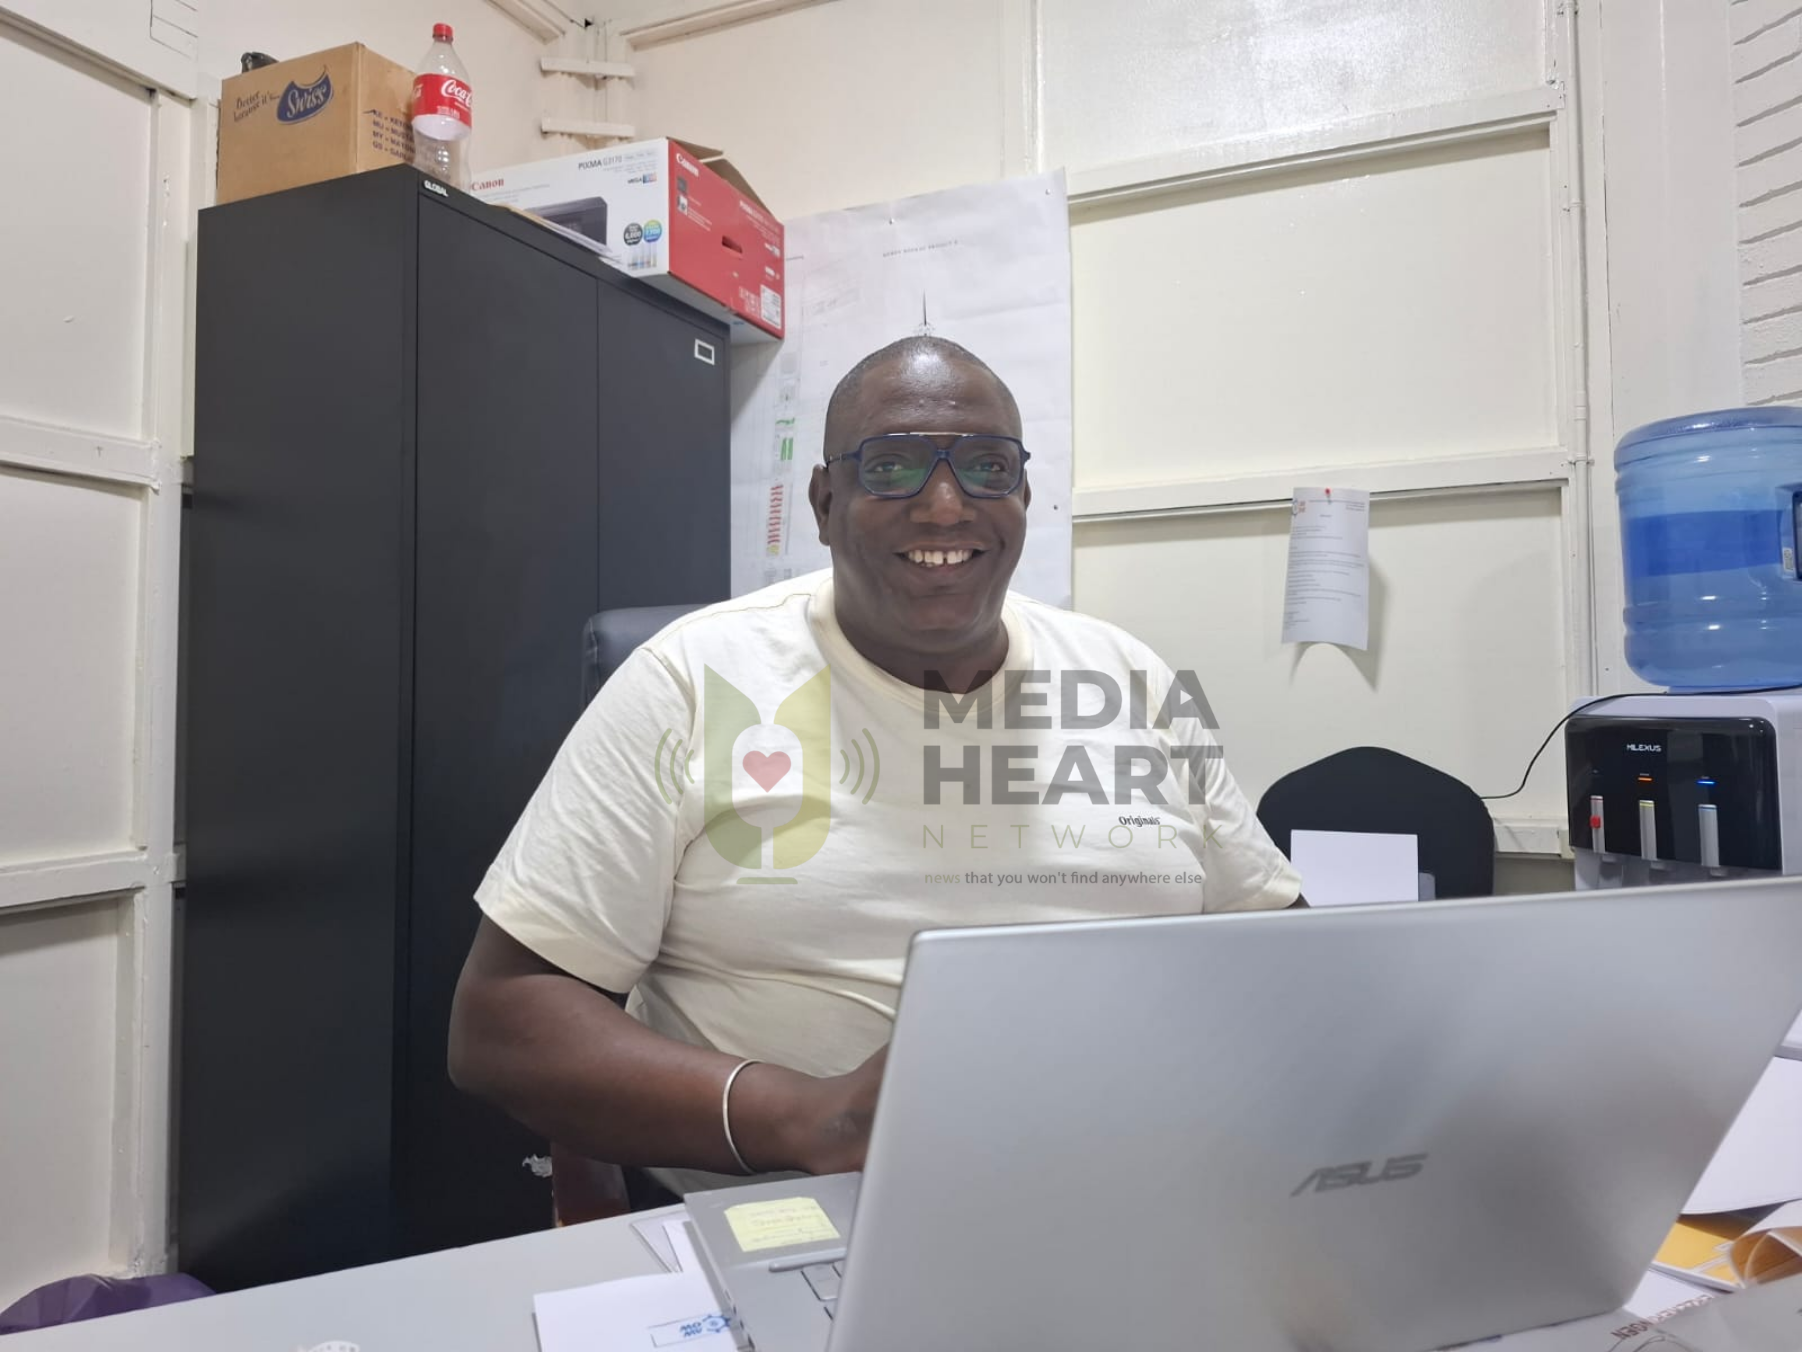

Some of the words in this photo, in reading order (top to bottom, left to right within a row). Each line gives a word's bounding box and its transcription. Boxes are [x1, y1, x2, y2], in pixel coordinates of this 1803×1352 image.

[286, 84, 328, 118] Swiss
[578, 159, 602, 171] PIXMA
[676, 153, 699, 178] Canon
[424, 180, 449, 197] GLOBAL
[471, 178, 504, 191] Canon
[1118, 815, 1161, 827] Originals
[1290, 1152, 1429, 1198] ASUS
